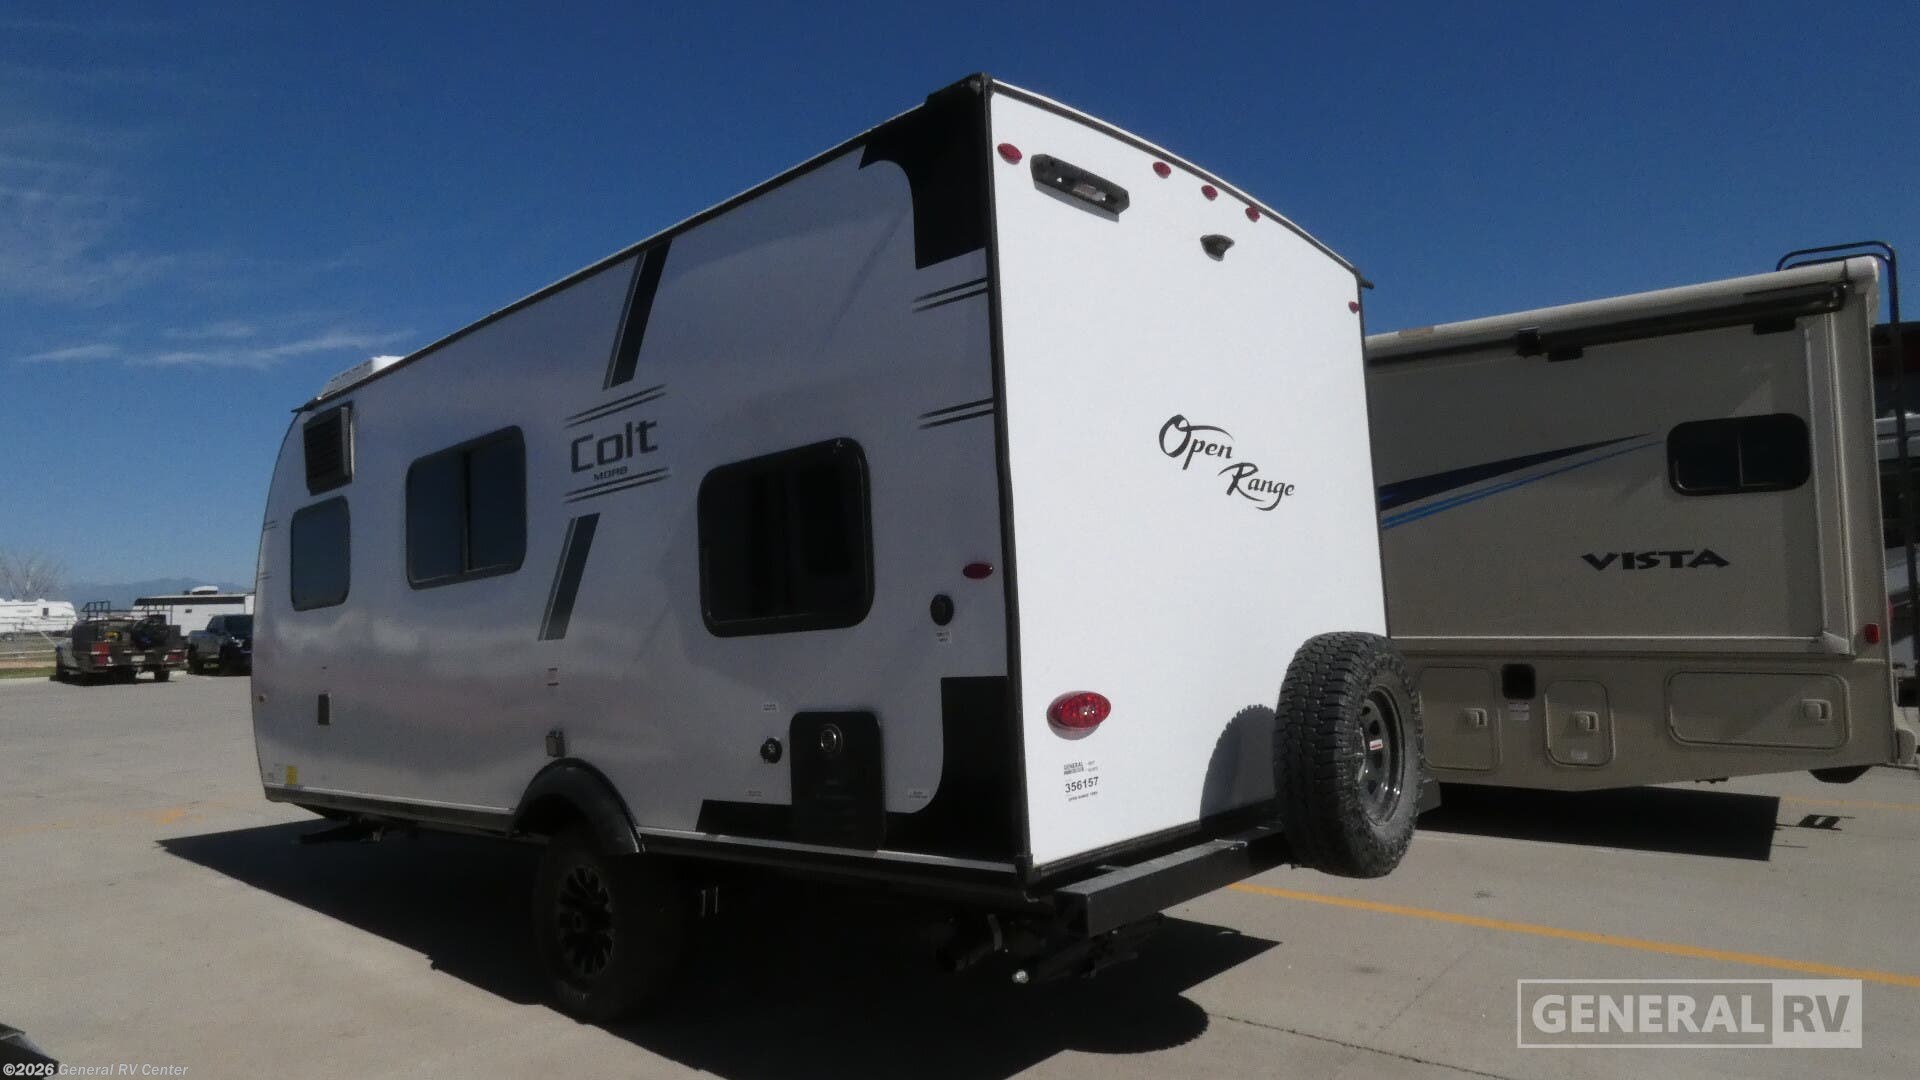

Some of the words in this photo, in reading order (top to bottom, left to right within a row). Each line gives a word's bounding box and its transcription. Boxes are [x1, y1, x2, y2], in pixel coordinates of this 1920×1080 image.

[570, 420, 659, 473] Colt
[1158, 414, 1235, 471] Open
[1217, 462, 1295, 511] Range
[1581, 549, 1731, 571] VISTA
[1064, 776, 1099, 793] 356157
